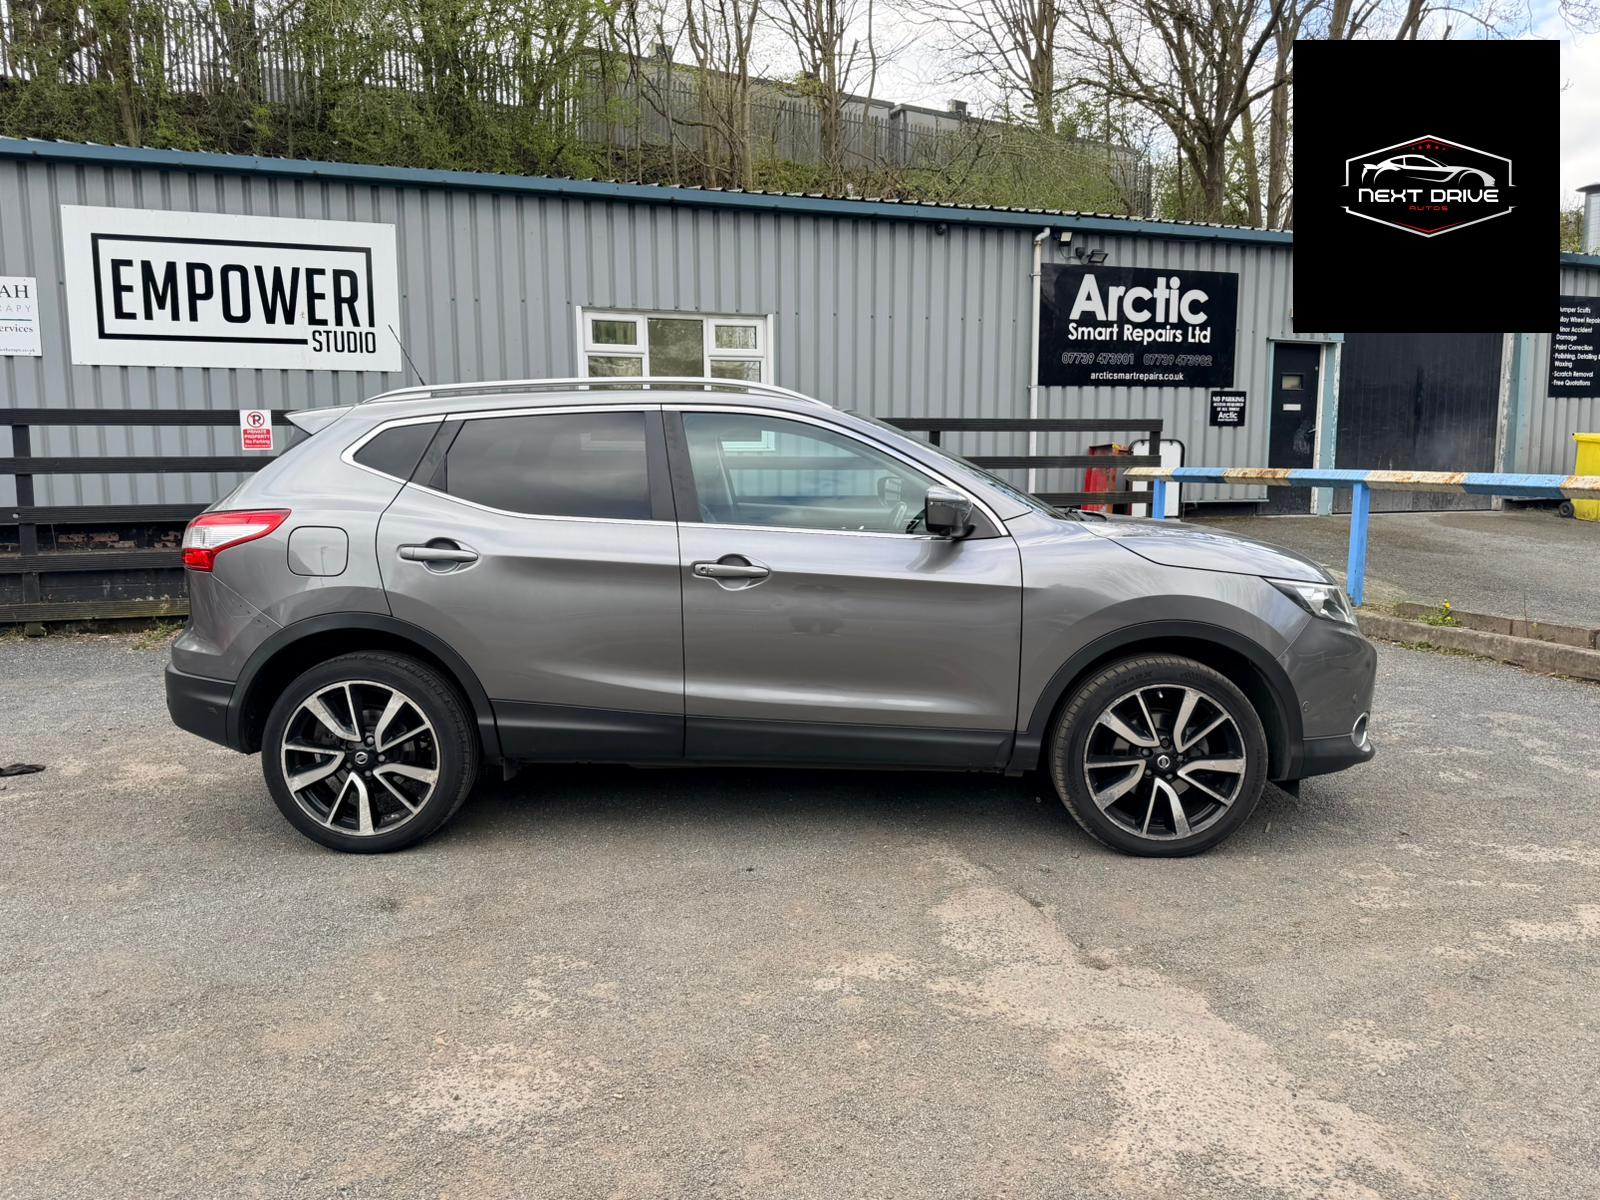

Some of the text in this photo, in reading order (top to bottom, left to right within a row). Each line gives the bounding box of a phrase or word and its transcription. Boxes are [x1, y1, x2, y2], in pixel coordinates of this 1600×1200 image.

[110, 258, 361, 328] EMPOWER
[1069, 273, 1209, 325] Arctic
[311, 330, 377, 354] STUDIO
[1068, 322, 1211, 345] Smart Repairs Ltd
[1061, 352, 1095, 365] 07739
[1143, 354, 1175, 366] 07739
[1090, 371, 1184, 382] arcticsmartrepairs.co.uk
